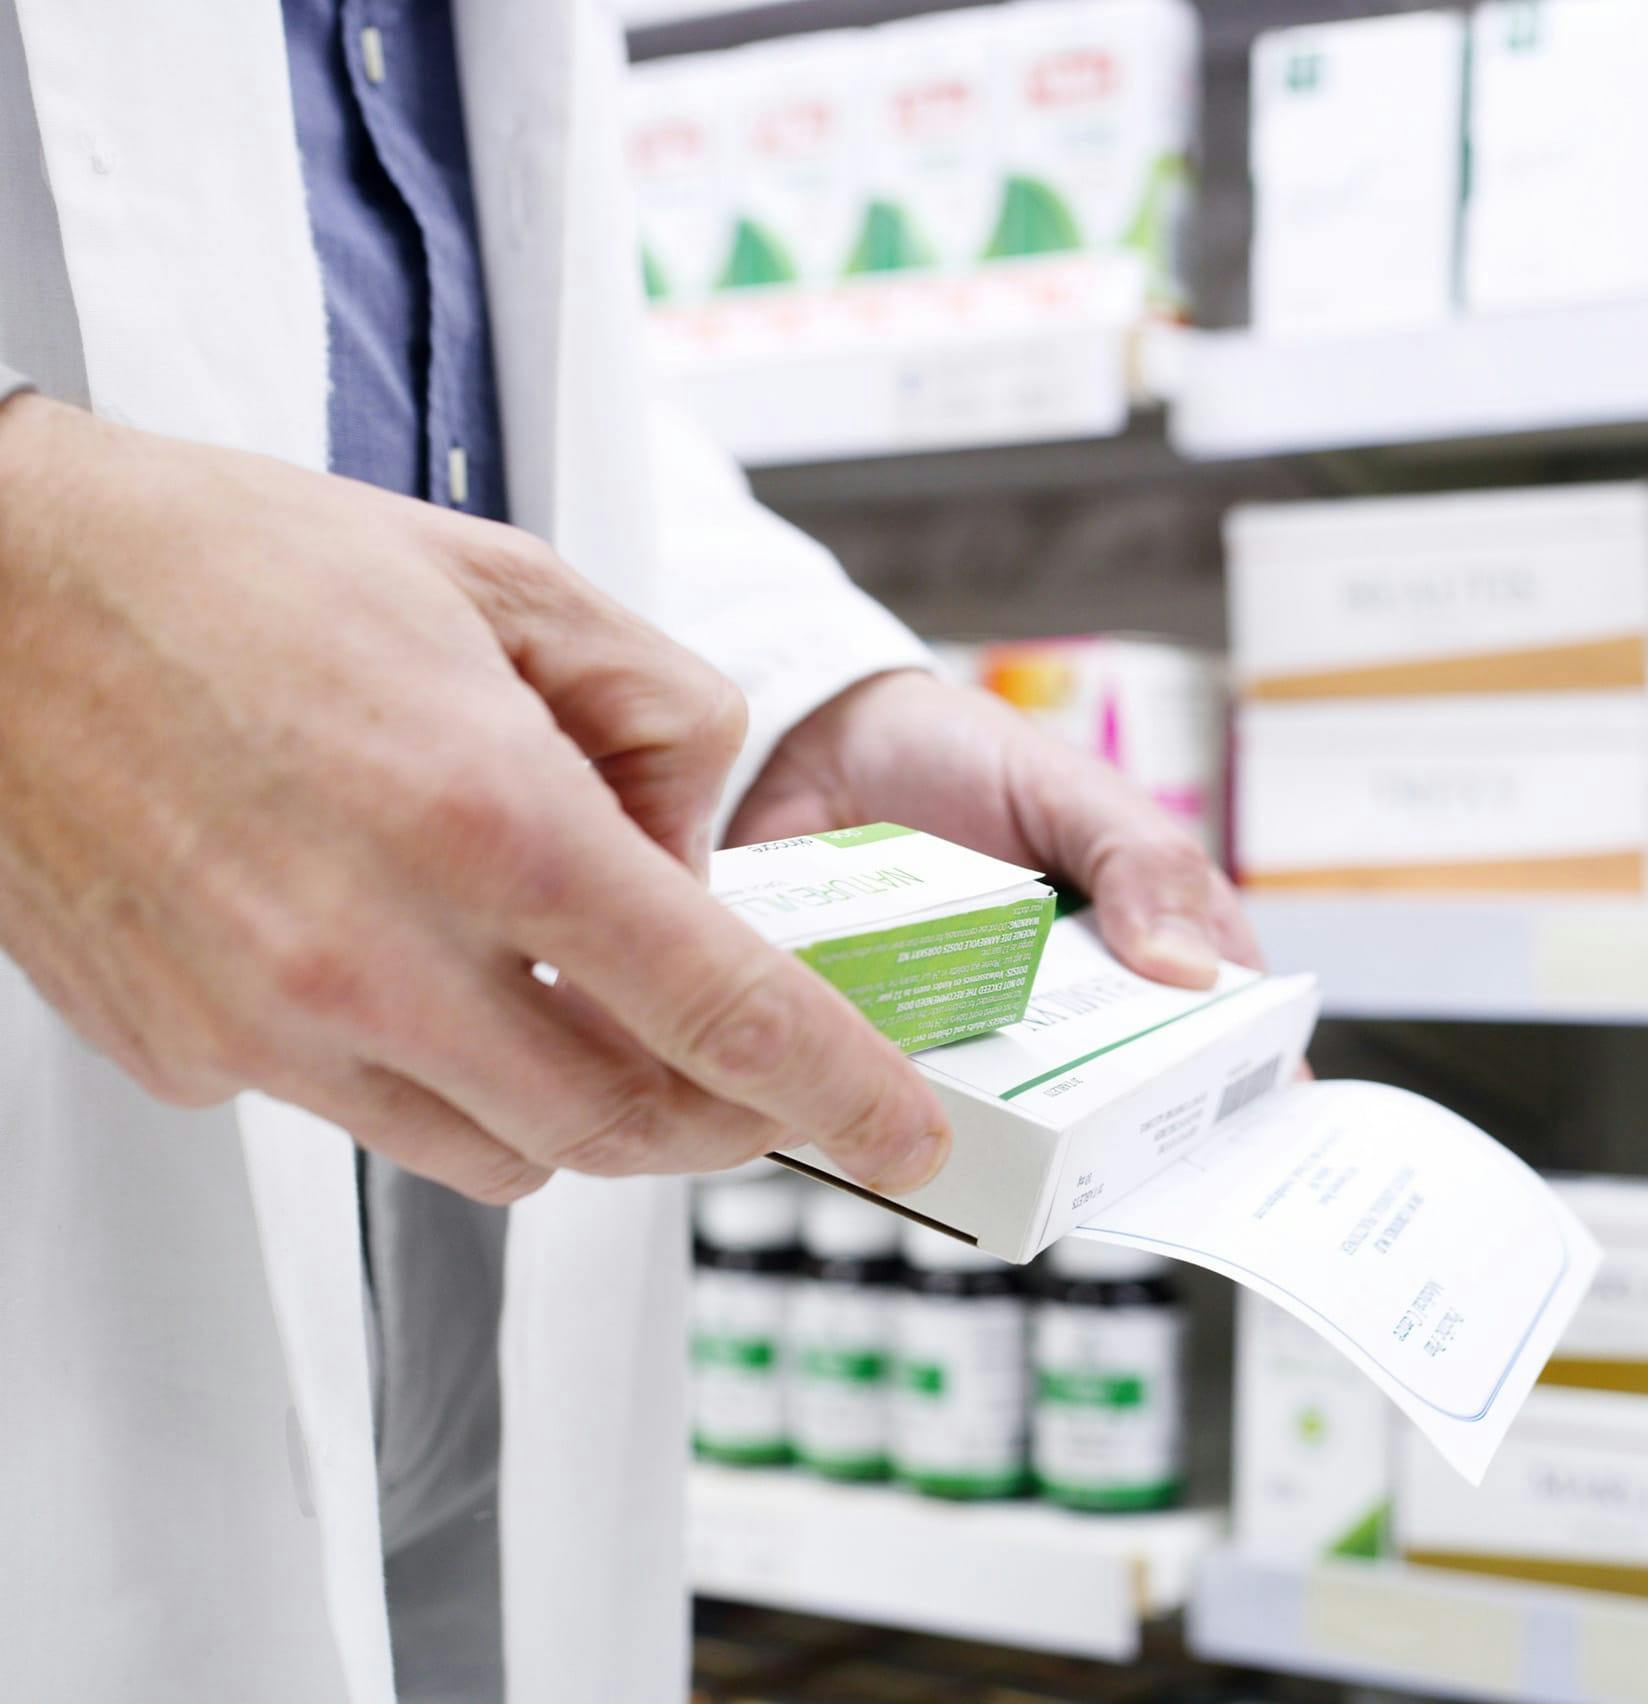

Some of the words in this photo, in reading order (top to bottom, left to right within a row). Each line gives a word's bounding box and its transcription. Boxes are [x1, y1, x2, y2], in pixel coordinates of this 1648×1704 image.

[1008, 915, 1038, 929] WARNING:
[1012, 928, 1036, 940] MOENIE
[1003, 979, 1015, 988] NOT
[1016, 977, 1024, 985] DO
[964, 987, 976, 997] THE
[978, 982, 1002, 994] EXCEED
[915, 990, 962, 1008] RECOMMENDED
[895, 1000, 913, 1012] DOSE
[928, 1028, 951, 1039] children
[953, 1025, 963, 1033] and
[911, 1033, 925, 1041] over
